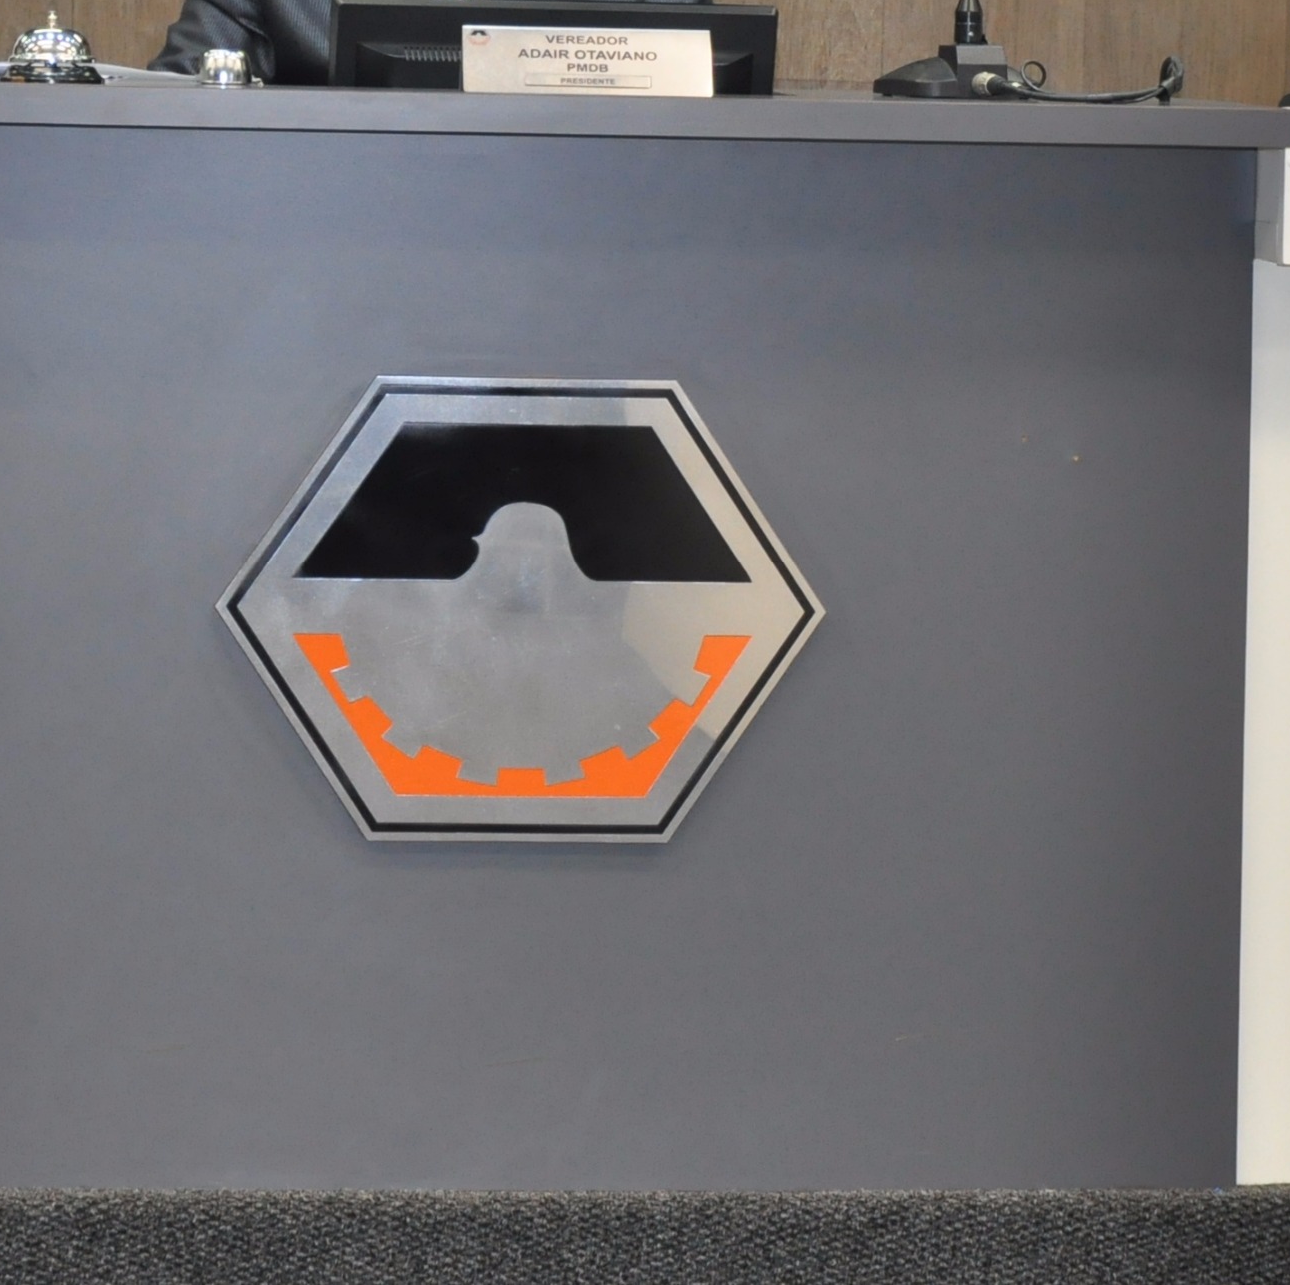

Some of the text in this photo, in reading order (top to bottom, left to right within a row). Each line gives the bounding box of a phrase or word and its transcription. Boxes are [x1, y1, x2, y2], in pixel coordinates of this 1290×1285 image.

[545, 35, 629, 46] VEREADOR
[518, 48, 658, 62] ADAIR OTAVIANO
[566, 63, 609, 73] PMDB
